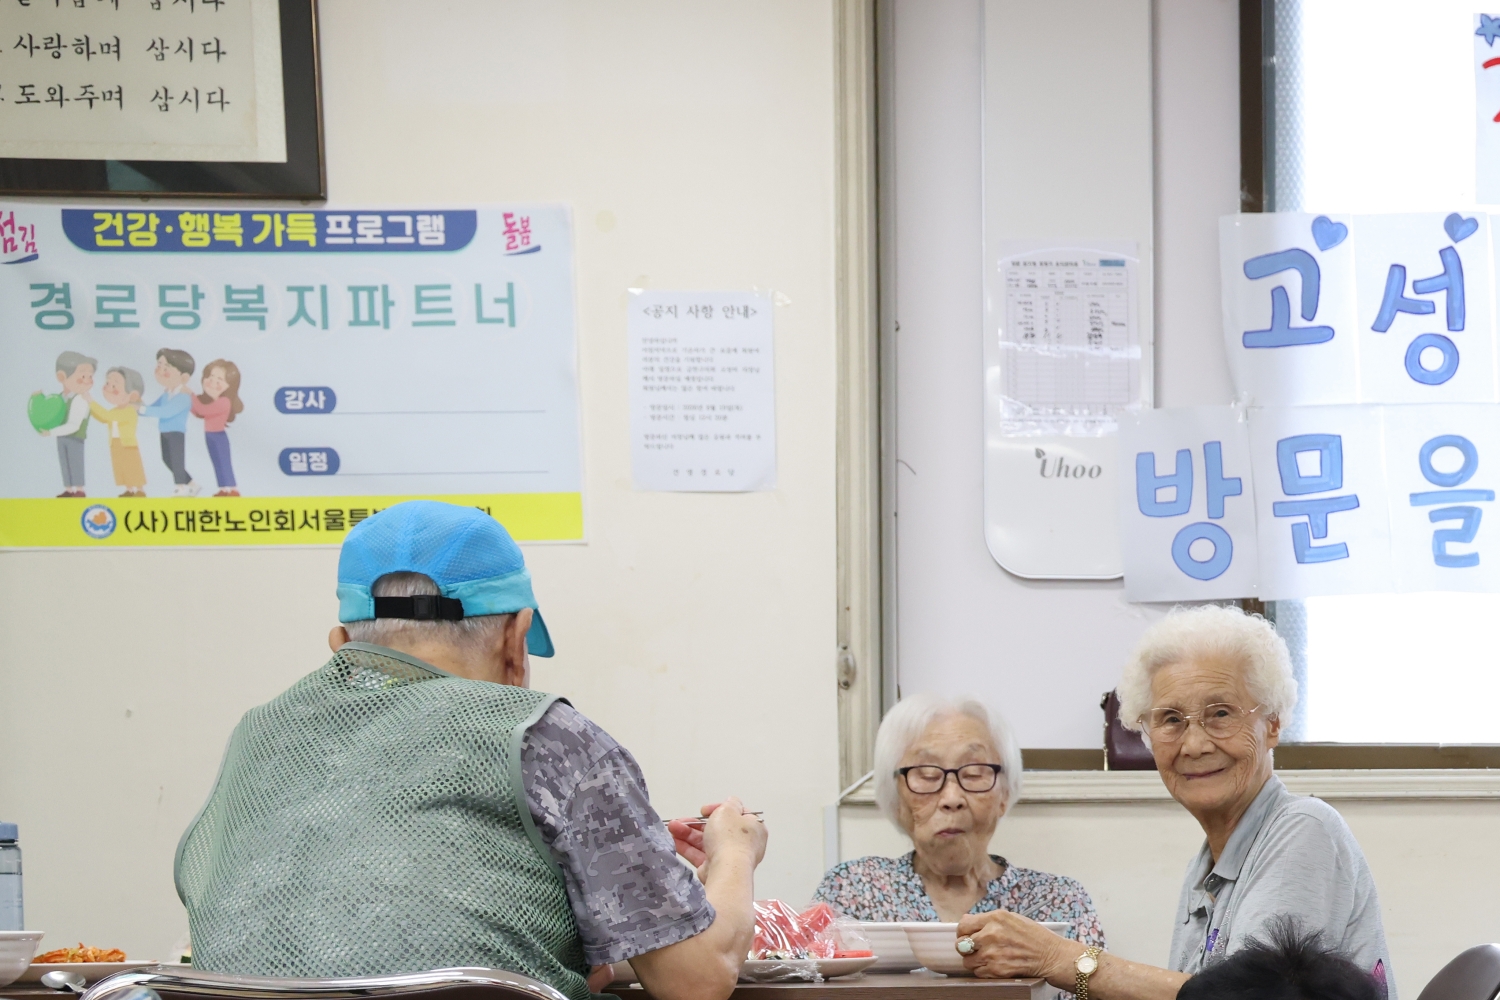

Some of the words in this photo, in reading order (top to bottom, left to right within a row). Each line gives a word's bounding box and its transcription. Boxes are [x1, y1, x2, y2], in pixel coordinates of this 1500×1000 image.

[13, 33, 121, 61] 사랑하며
[14, 84, 123, 111] 도와주며
[252, 212, 317, 247] 가득
[325, 214, 445, 246] 프로그램
[502, 211, 532, 250] 돌봄
[685, 304, 714, 319] 사항
[284, 389, 327, 410] 강사
[288, 451, 329, 473] 일정
[1040, 456, 1102, 479] Uhoo
